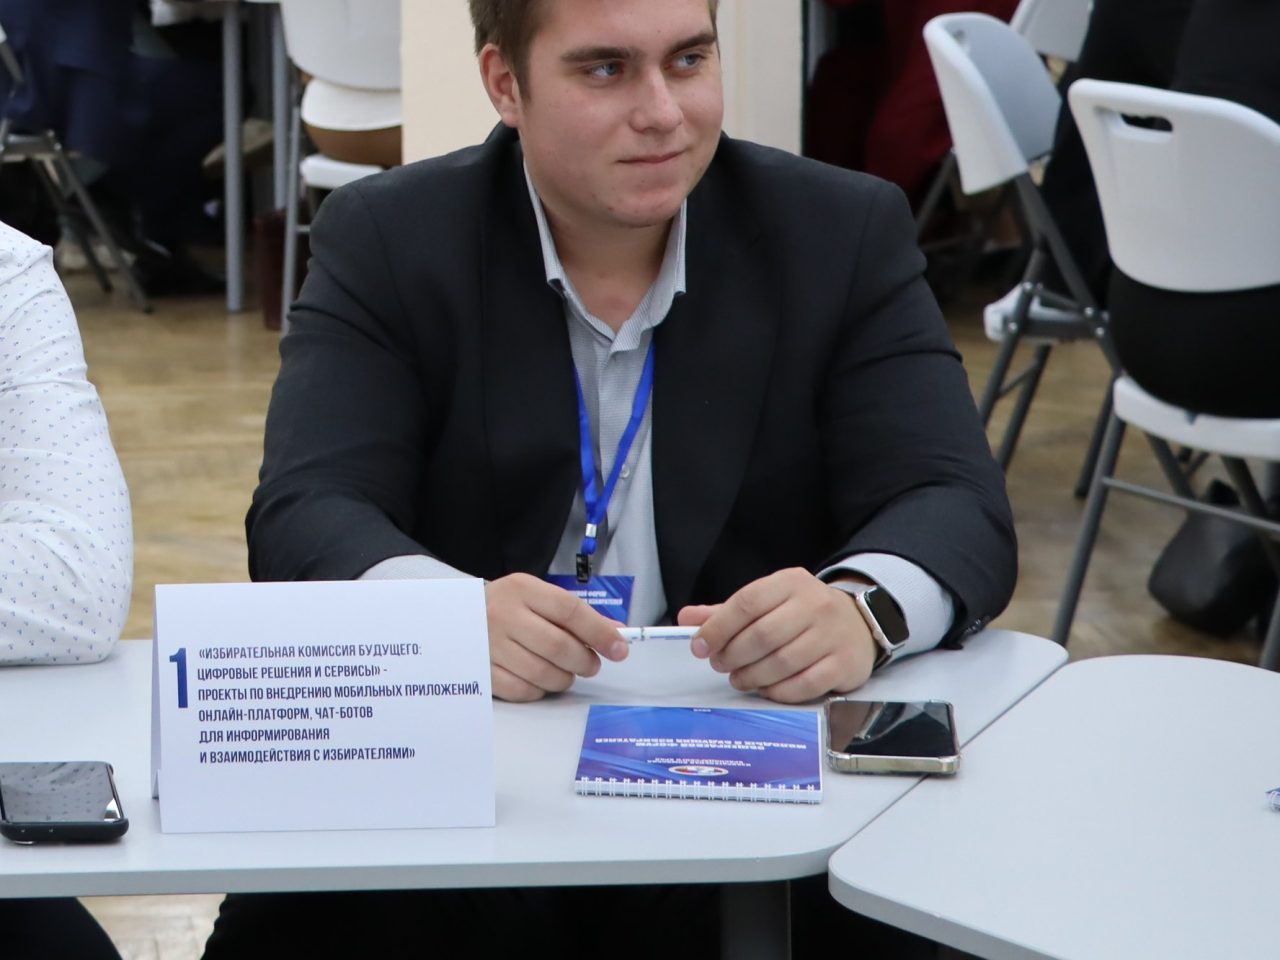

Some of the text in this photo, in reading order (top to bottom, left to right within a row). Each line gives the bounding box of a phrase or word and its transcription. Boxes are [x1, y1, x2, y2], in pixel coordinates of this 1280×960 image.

[198, 642, 422, 660] «ИЗБИРАТЕЛЬНАЯ КОМИССИЯ БУДУЩЕГО:
[169, 647, 188, 709] 1
[197, 666, 259, 681] ЦИФРОВЫЕ
[261, 665, 312, 679] РЕШЕНИЯ
[314, 665, 322, 678] И
[324, 664, 381, 678] СЕРВИСЫ»
[198, 680, 483, 701] ПРОЕКТЫ ПО ВНЕДРЕНИЮ МОБИЛЬНЫХ ПРИЛОЖЕНИЙ,
[198, 706, 374, 722] ОНЛАЙН-ПЛАТФОРМ, ЧАТ-БОТОВ
[199, 728, 330, 744] ДЛЯ ИНФОРМИРОВАНИЯ
[199, 747, 416, 764] И ВЗАИМОДЕЙСТВИЯ С ИЗБИРАТЕЛЯМИ»
